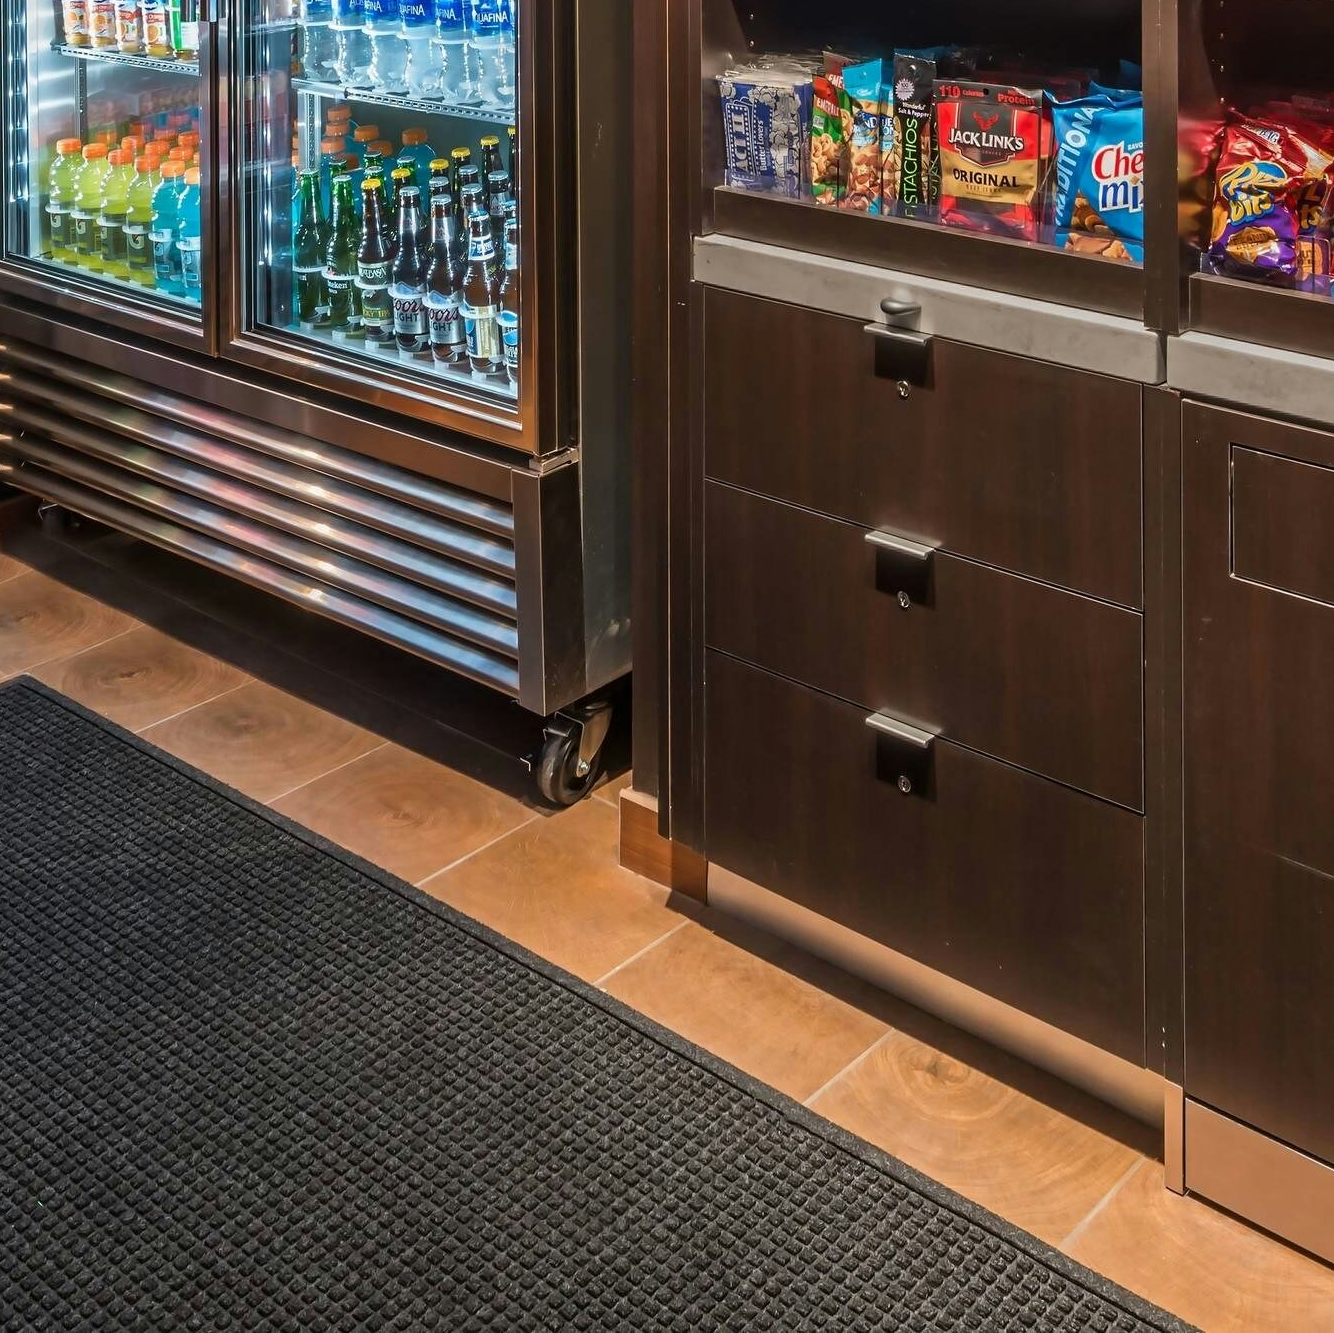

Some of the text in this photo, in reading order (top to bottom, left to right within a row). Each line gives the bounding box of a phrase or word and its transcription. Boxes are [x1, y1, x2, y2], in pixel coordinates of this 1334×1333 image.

[939, 85, 960, 98] 110
[997, 93, 1035, 104] Protein
[912, 110, 929, 118] Pepper
[949, 128, 1024, 151] JACK LINK'S
[953, 168, 1020, 187] ORIGINAL
